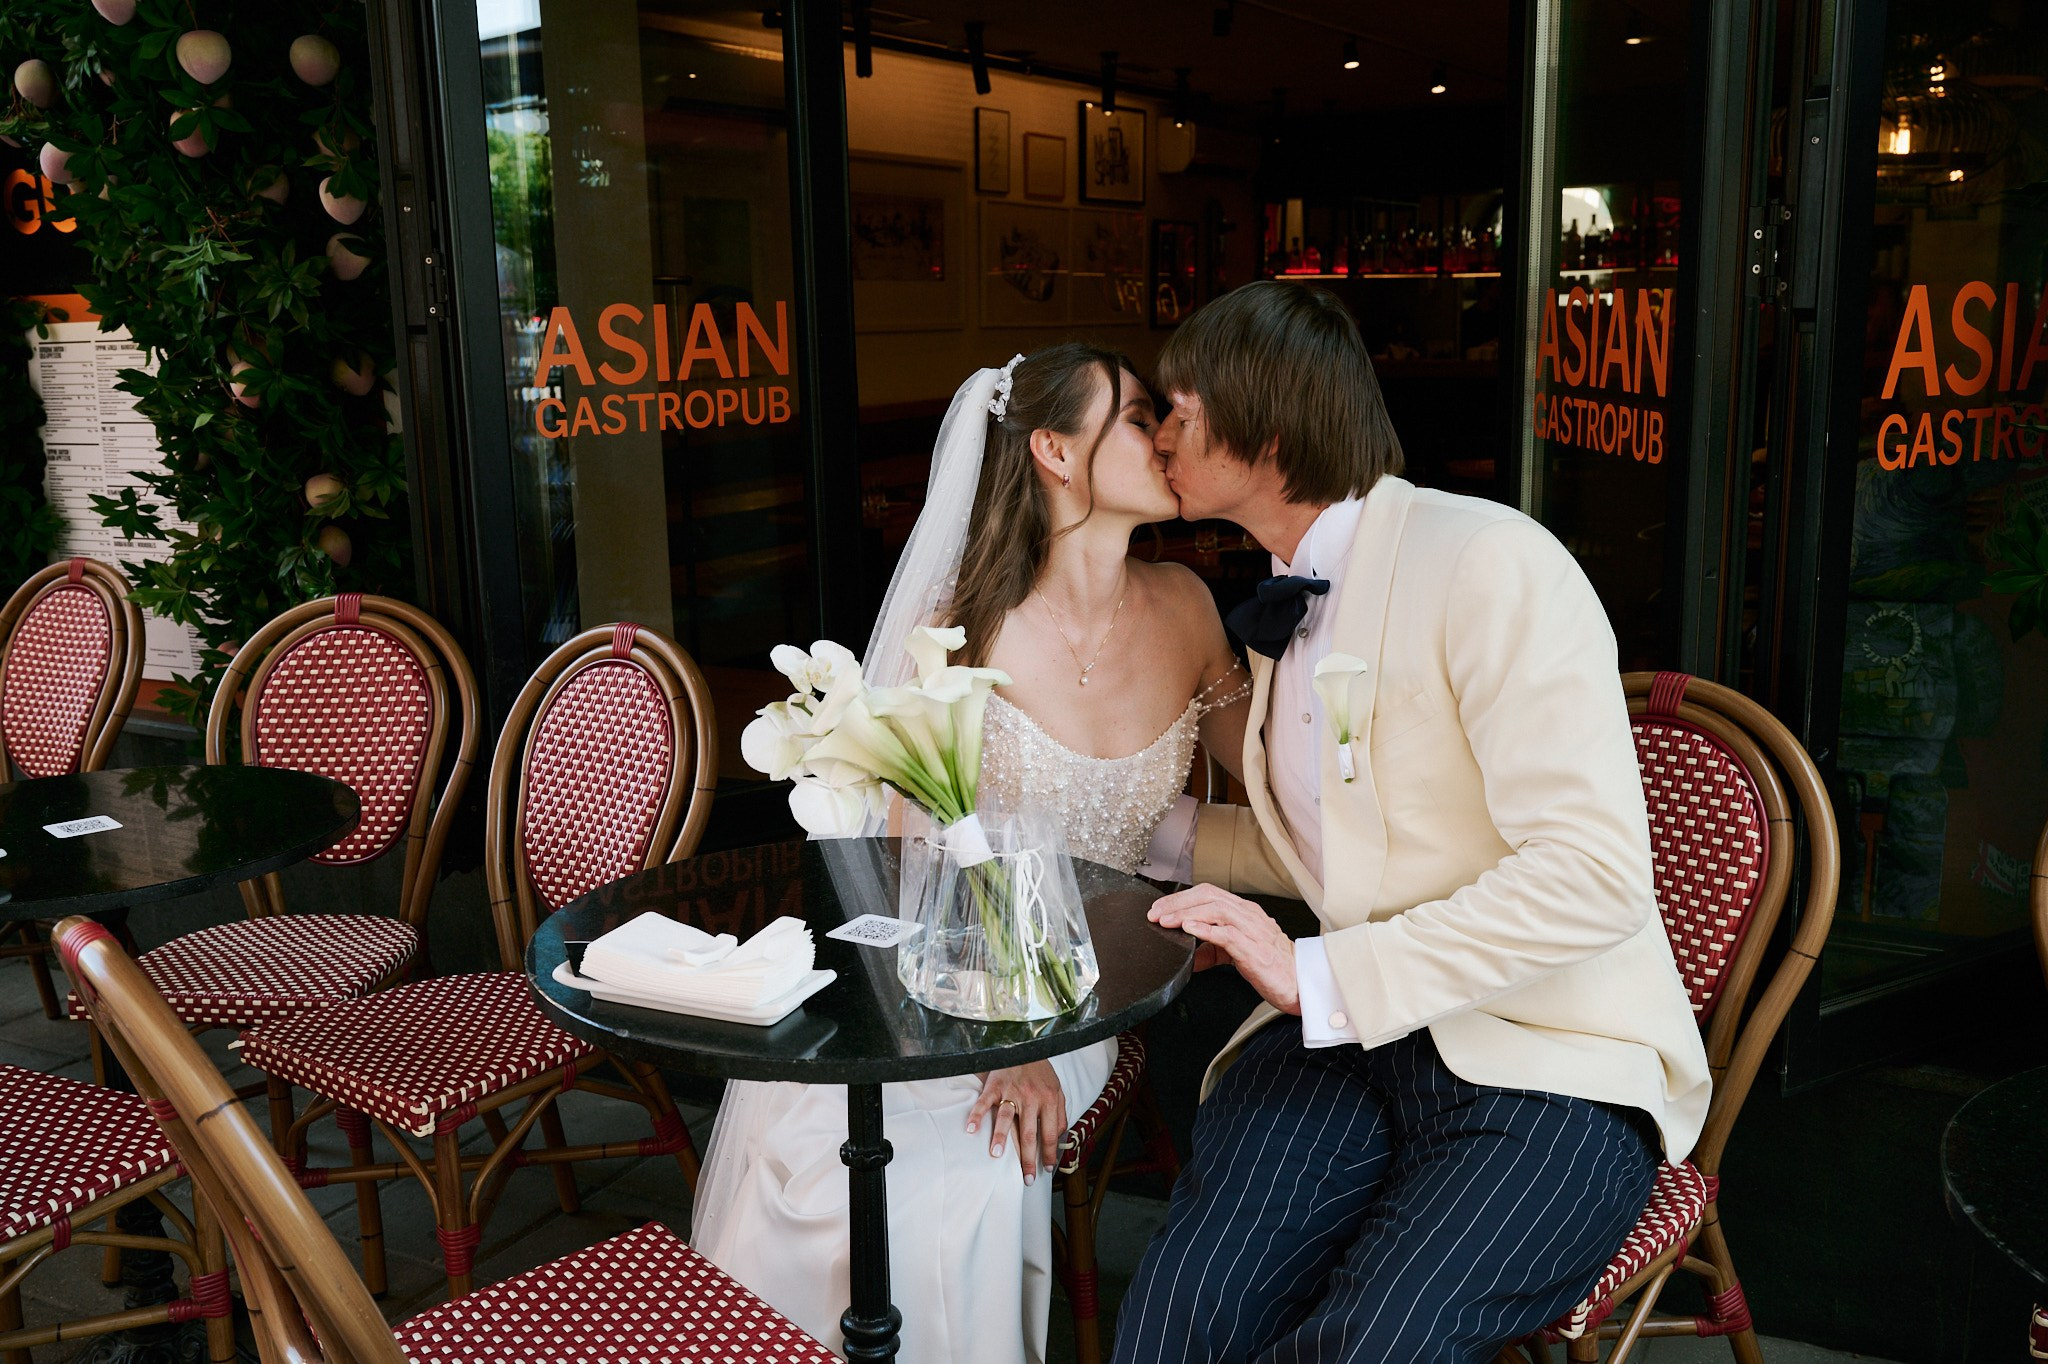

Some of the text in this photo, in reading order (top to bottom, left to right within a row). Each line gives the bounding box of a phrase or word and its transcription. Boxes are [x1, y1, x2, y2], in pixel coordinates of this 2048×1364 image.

[533, 300, 790, 388] ASIAN
[1535, 286, 1671, 398] ASIAN
[535, 385, 792, 439] GASTROPUB
[1533, 391, 1664, 465] GASTROPUB
[1877, 403, 2048, 471] GASTRO
